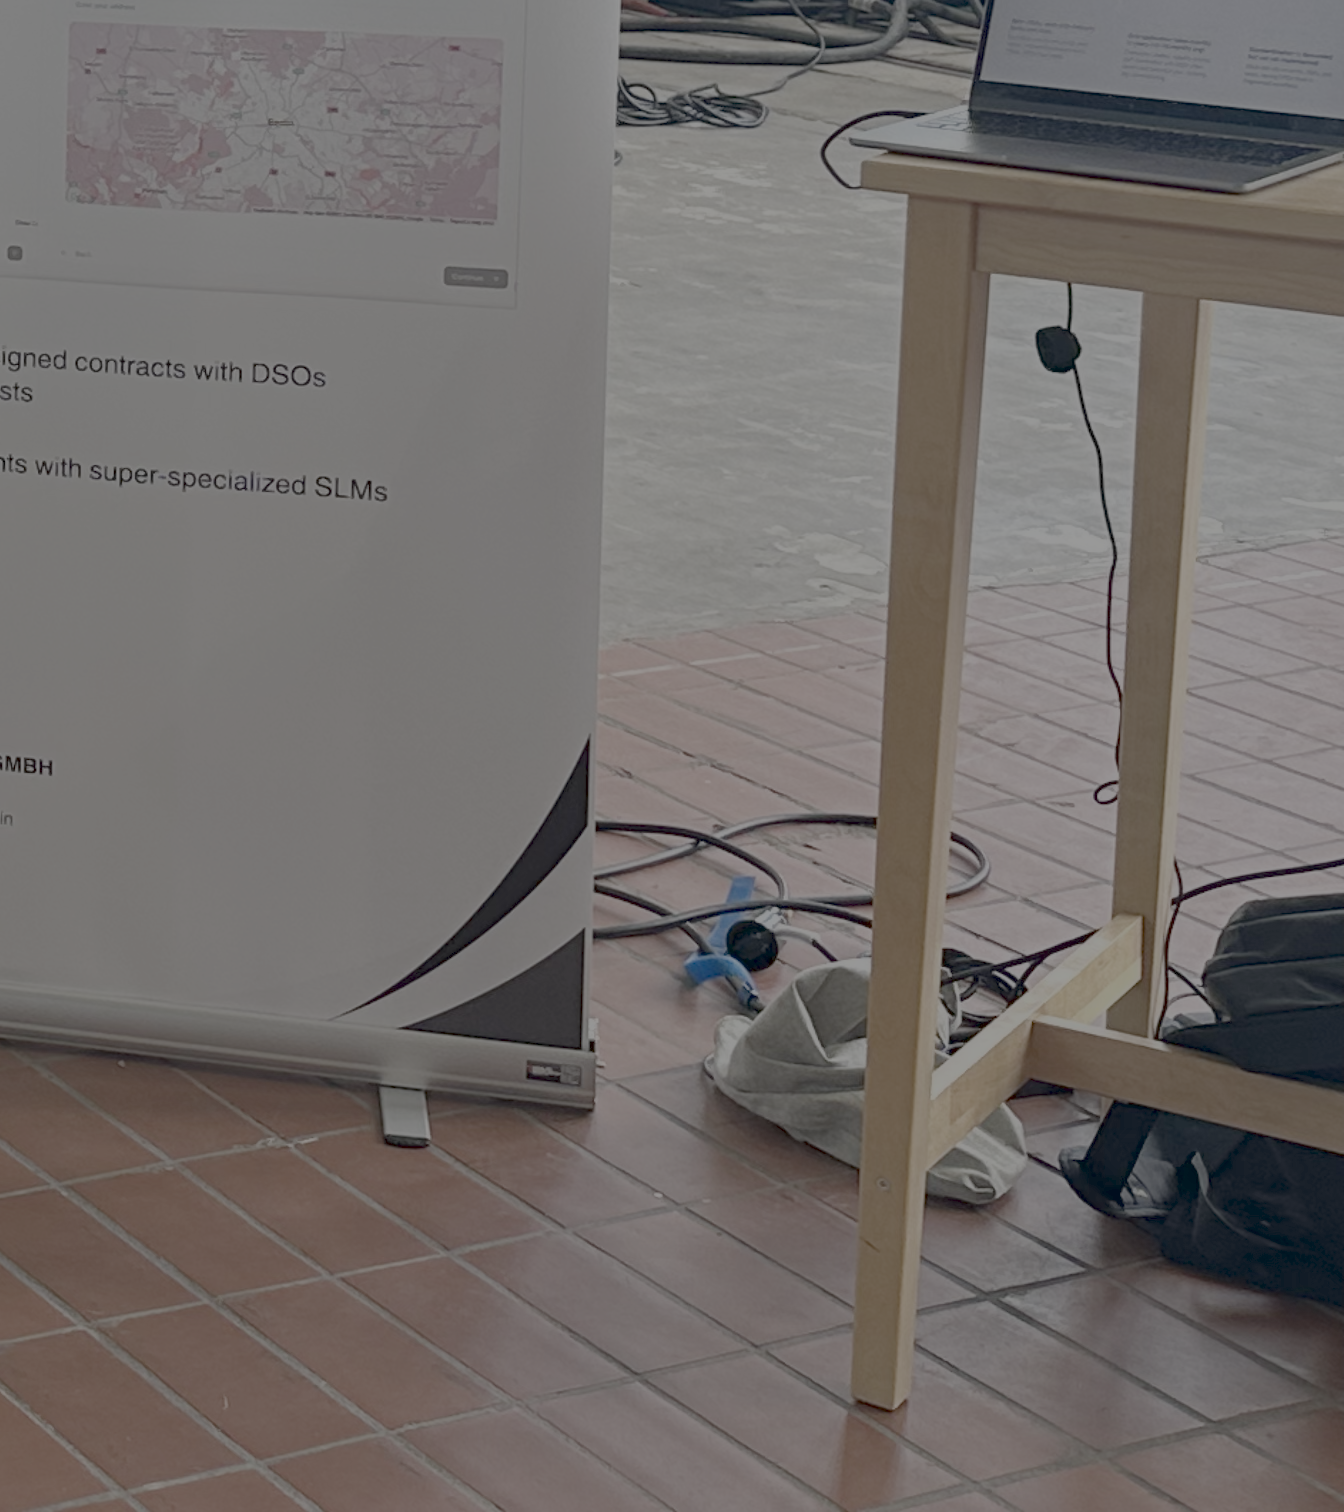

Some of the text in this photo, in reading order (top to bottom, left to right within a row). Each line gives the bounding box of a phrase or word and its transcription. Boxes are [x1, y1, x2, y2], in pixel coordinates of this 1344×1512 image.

[75, 356, 185, 378] contracts
[194, 363, 242, 382] with
[253, 363, 325, 387] DSOs
[35, 458, 81, 478] with
[90, 465, 306, 495] super-specialized
[315, 476, 387, 501] SLMs
